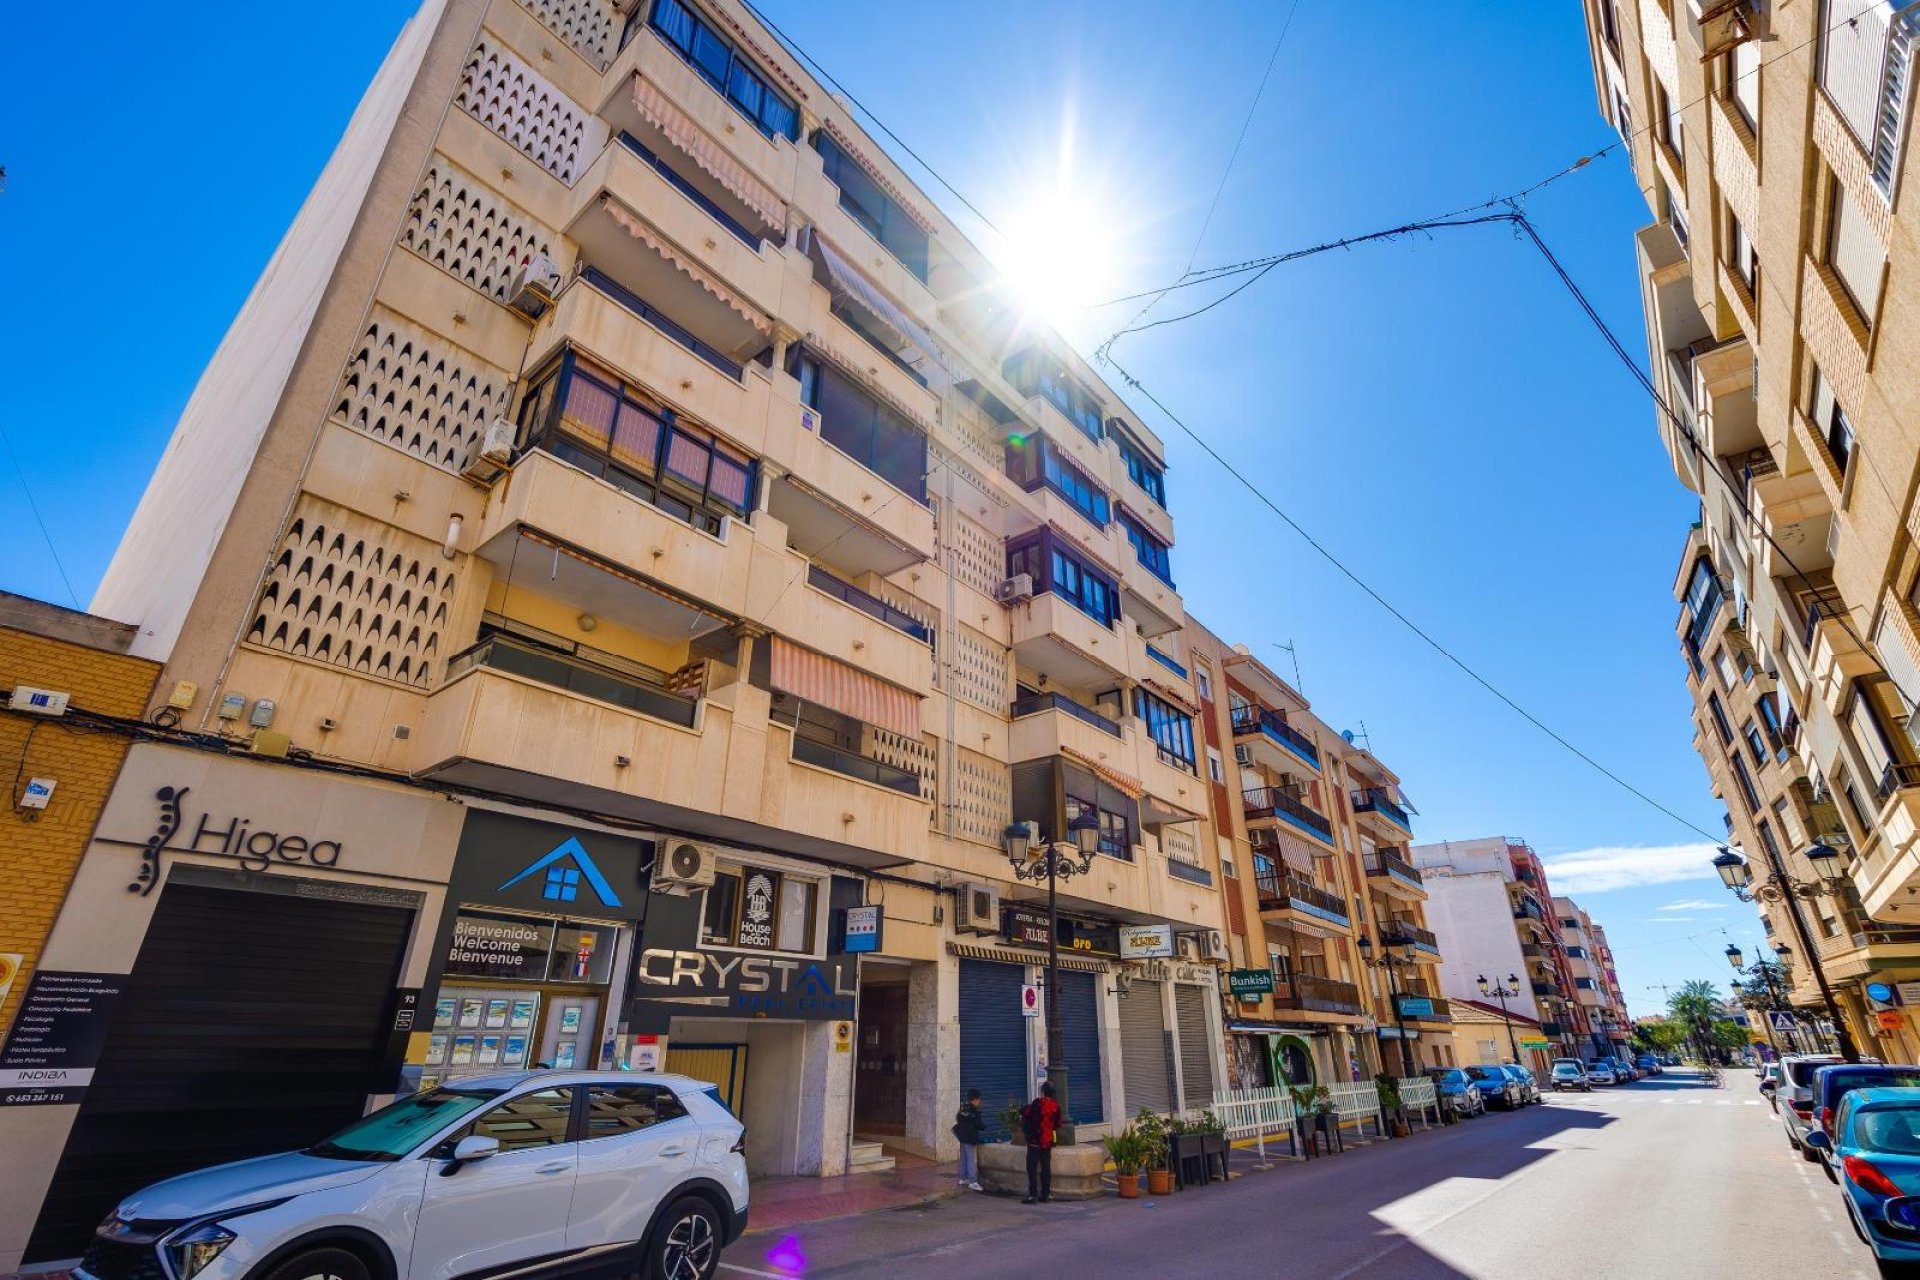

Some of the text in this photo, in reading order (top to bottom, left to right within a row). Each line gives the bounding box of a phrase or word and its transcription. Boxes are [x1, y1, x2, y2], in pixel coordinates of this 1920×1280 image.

[191, 812, 343, 873] Higea
[455, 921, 539, 941] Bienvenidos
[740, 921, 771, 934] House
[453, 935, 521, 952] Welcome
[739, 933, 770, 946] Beach
[448, 948, 524, 966] Bienvenue
[638, 947, 856, 997] CRYSTAL
[1230, 974, 1271, 986] Bunkish
[18, 1070, 68, 1080] INDIBA
[15, 1094, 32, 1102] 653
[50, 1093, 65, 1101] 151
